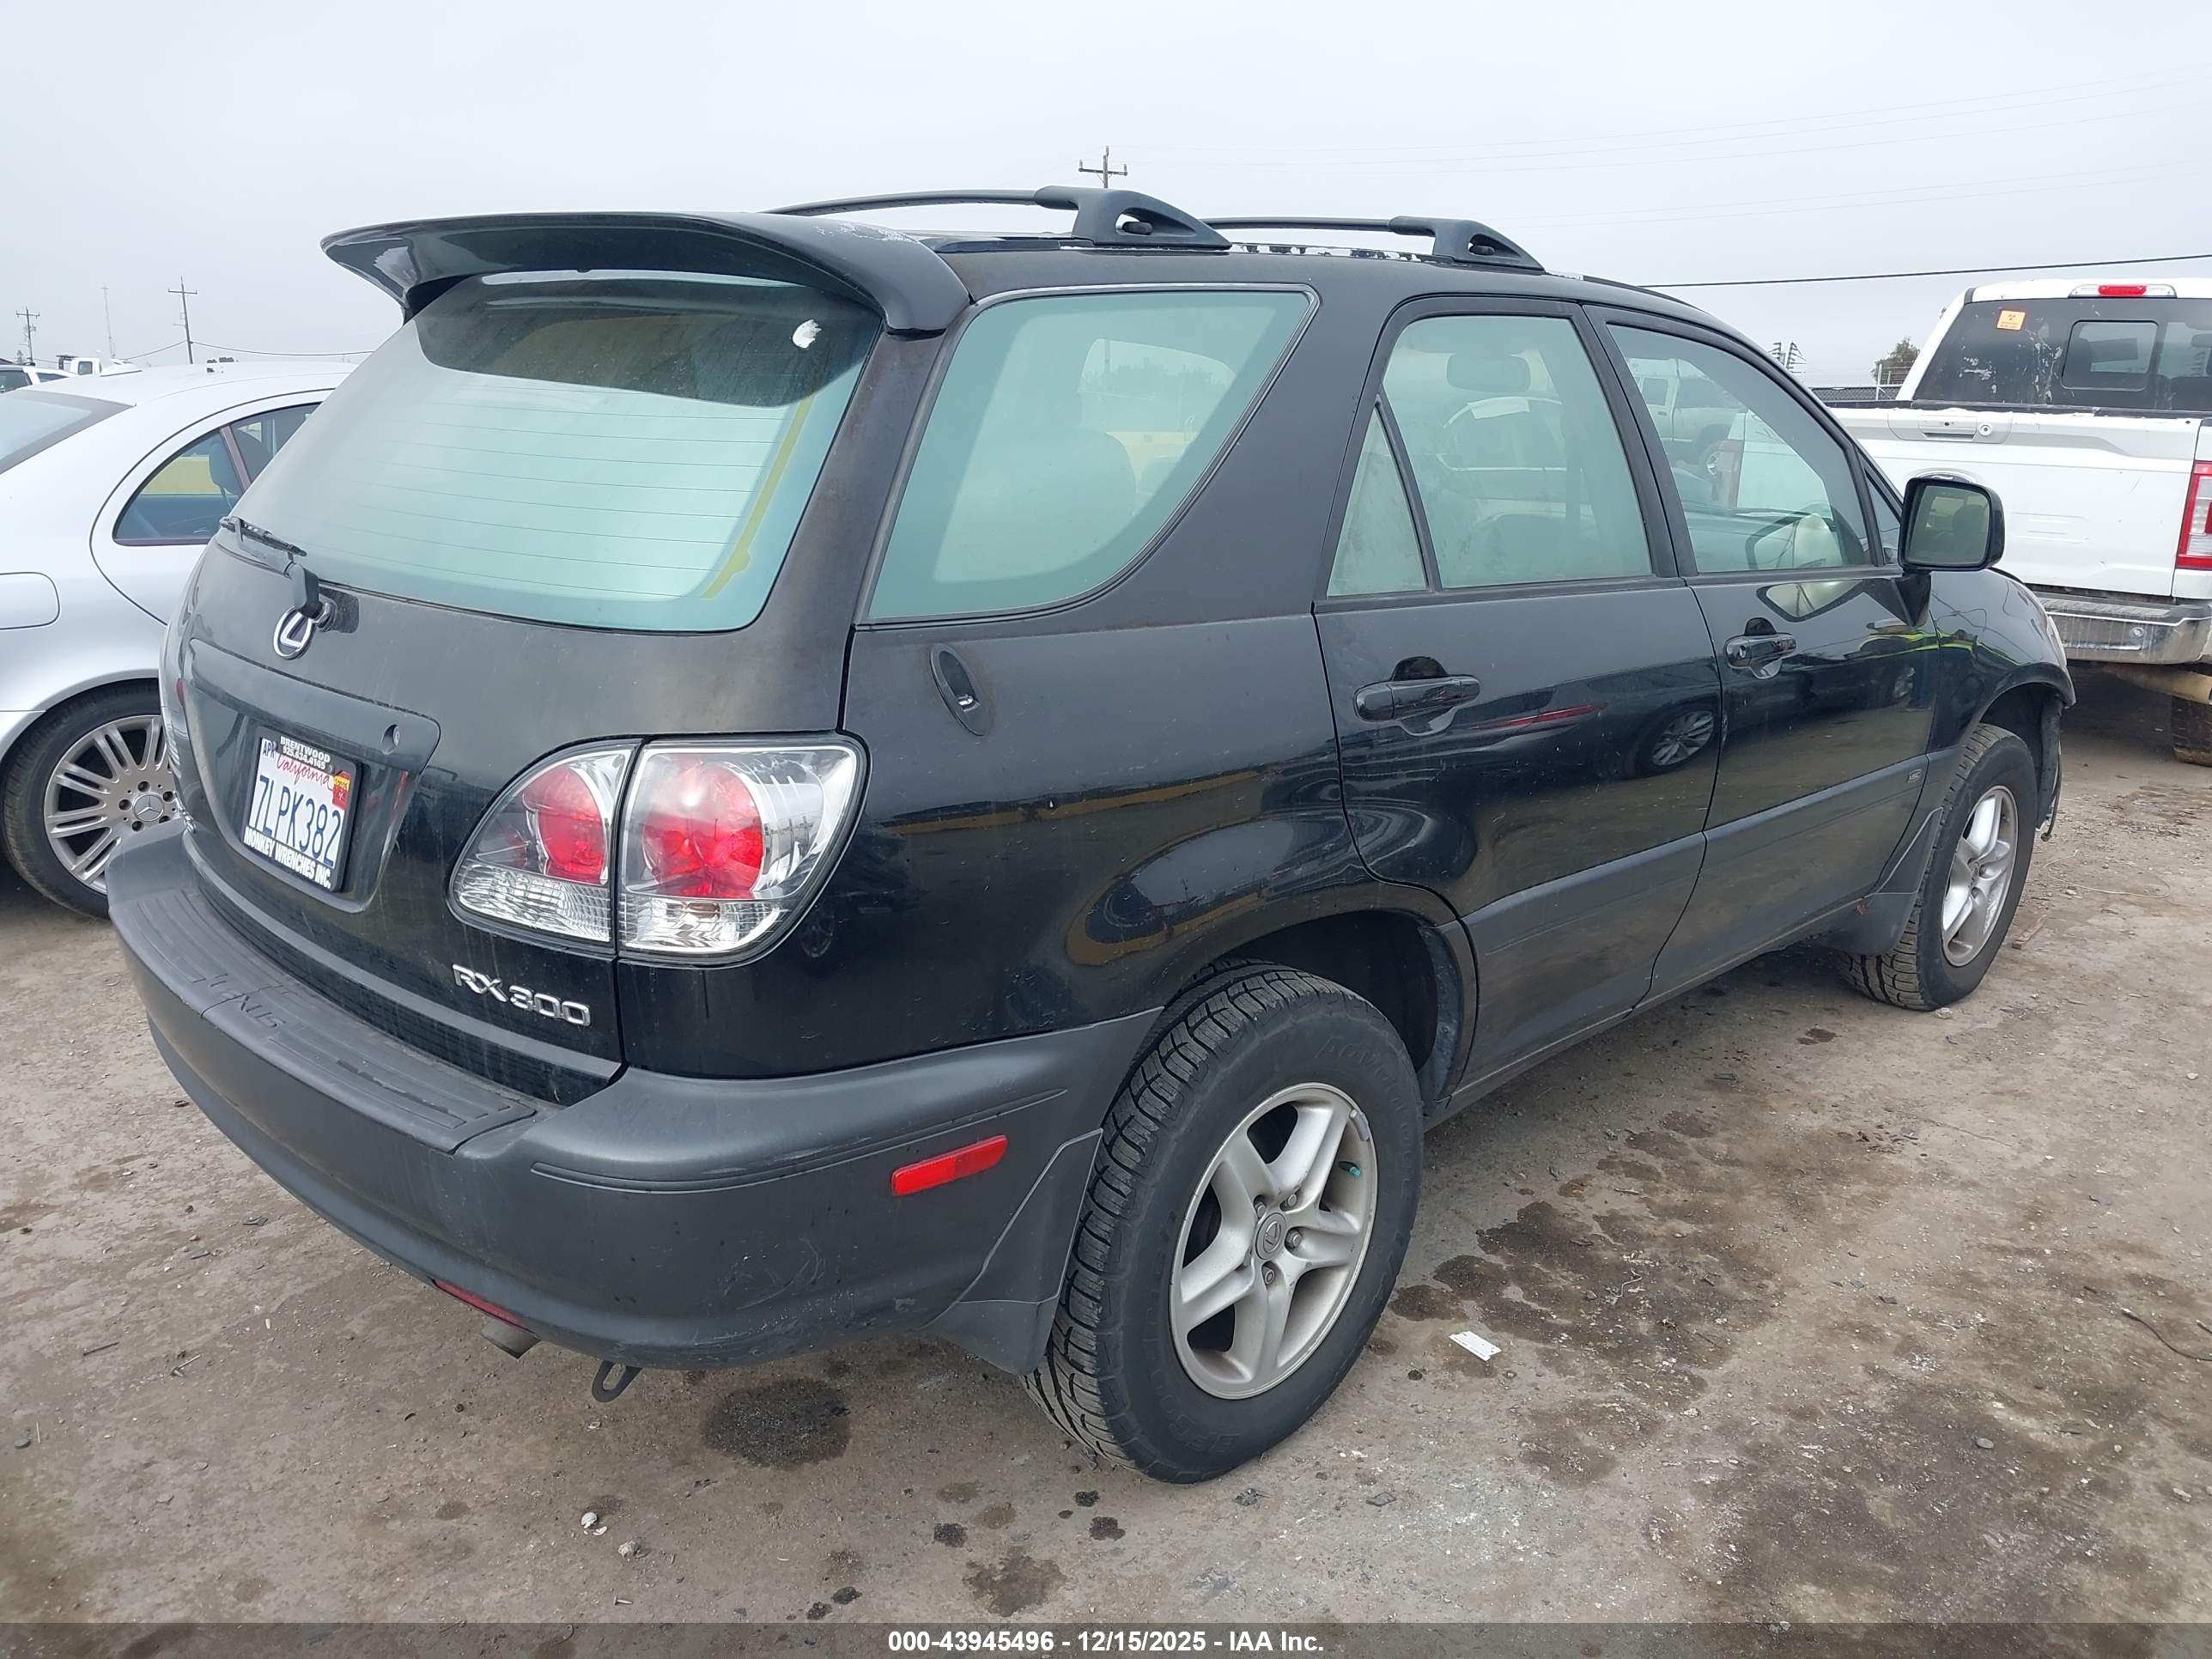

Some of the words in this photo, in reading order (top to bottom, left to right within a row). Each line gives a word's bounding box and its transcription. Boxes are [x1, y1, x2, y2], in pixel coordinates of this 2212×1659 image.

[262, 739, 276, 759] APR
[280, 736, 331, 763] BRENTWOOD
[283, 746, 326, 770] 925.634.4145
[276, 755, 333, 791] California
[254, 775, 341, 867] 7LPK382
[244, 825, 276, 858] MONKEY
[275, 842, 316, 880] WRENCHES
[314, 863, 332, 890] INC.
